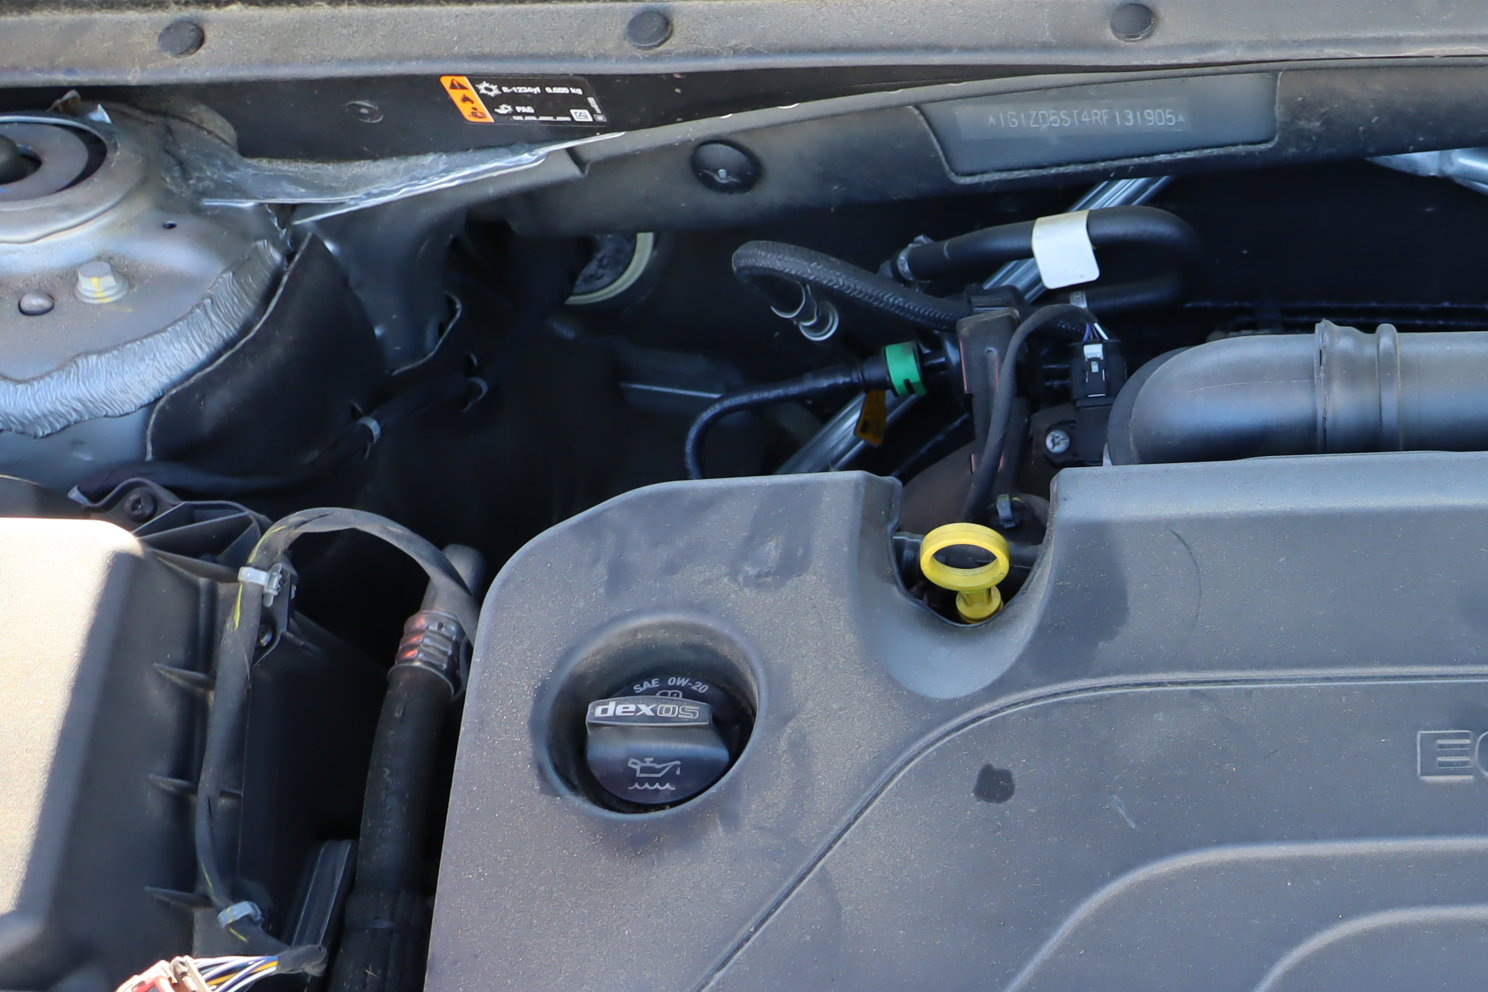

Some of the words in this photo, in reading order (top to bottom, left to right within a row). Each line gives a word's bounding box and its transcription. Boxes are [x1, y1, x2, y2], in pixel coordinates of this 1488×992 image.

[633, 678, 660, 694] SAE
[667, 676, 709, 694] 0W-20
[594, 701, 700, 719] dexos
